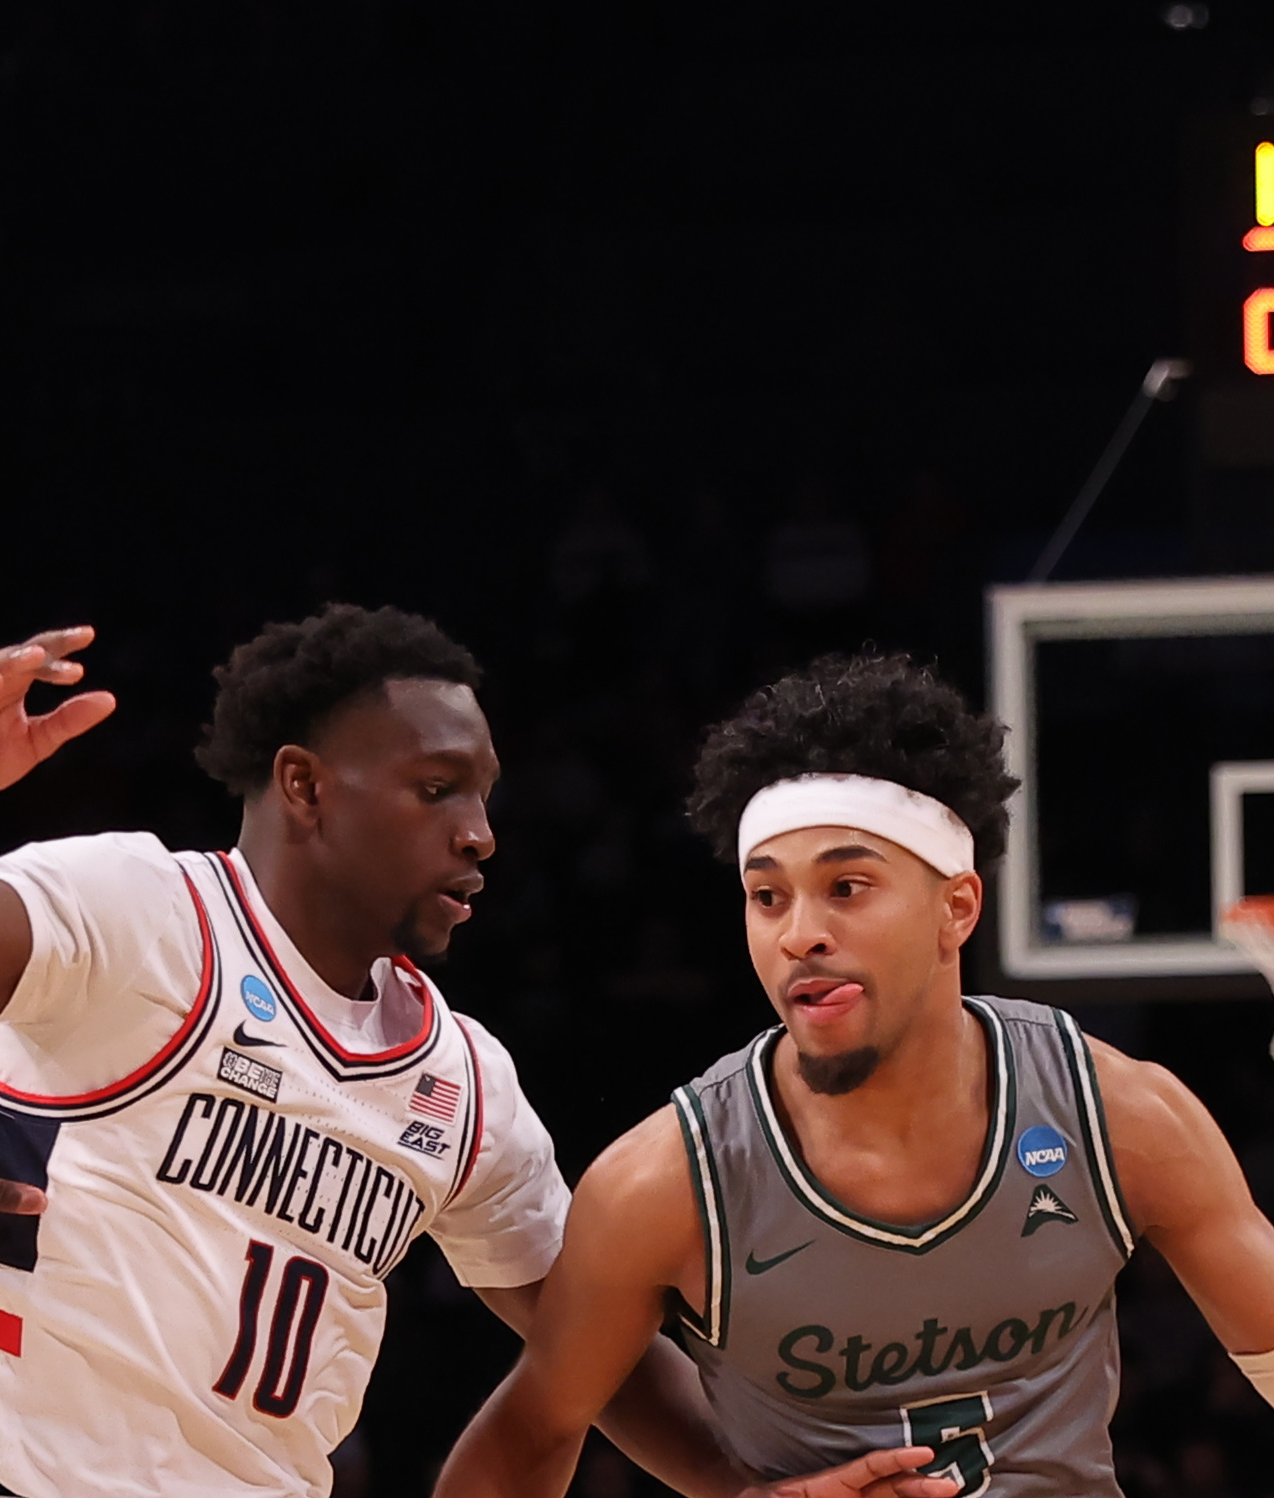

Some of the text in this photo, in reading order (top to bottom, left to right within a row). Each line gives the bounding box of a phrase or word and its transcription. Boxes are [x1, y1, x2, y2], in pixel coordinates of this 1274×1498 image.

[220, 1066, 277, 1099] CHANGE
[399, 1130, 451, 1155] EAST
[407, 1120, 445, 1140] BIG
[1025, 1147, 1066, 1167] NCAA
[156, 1092, 426, 1281] CONNECTICUT
[211, 1238, 329, 1419] 10
[775, 1301, 1089, 1399] Stetson
